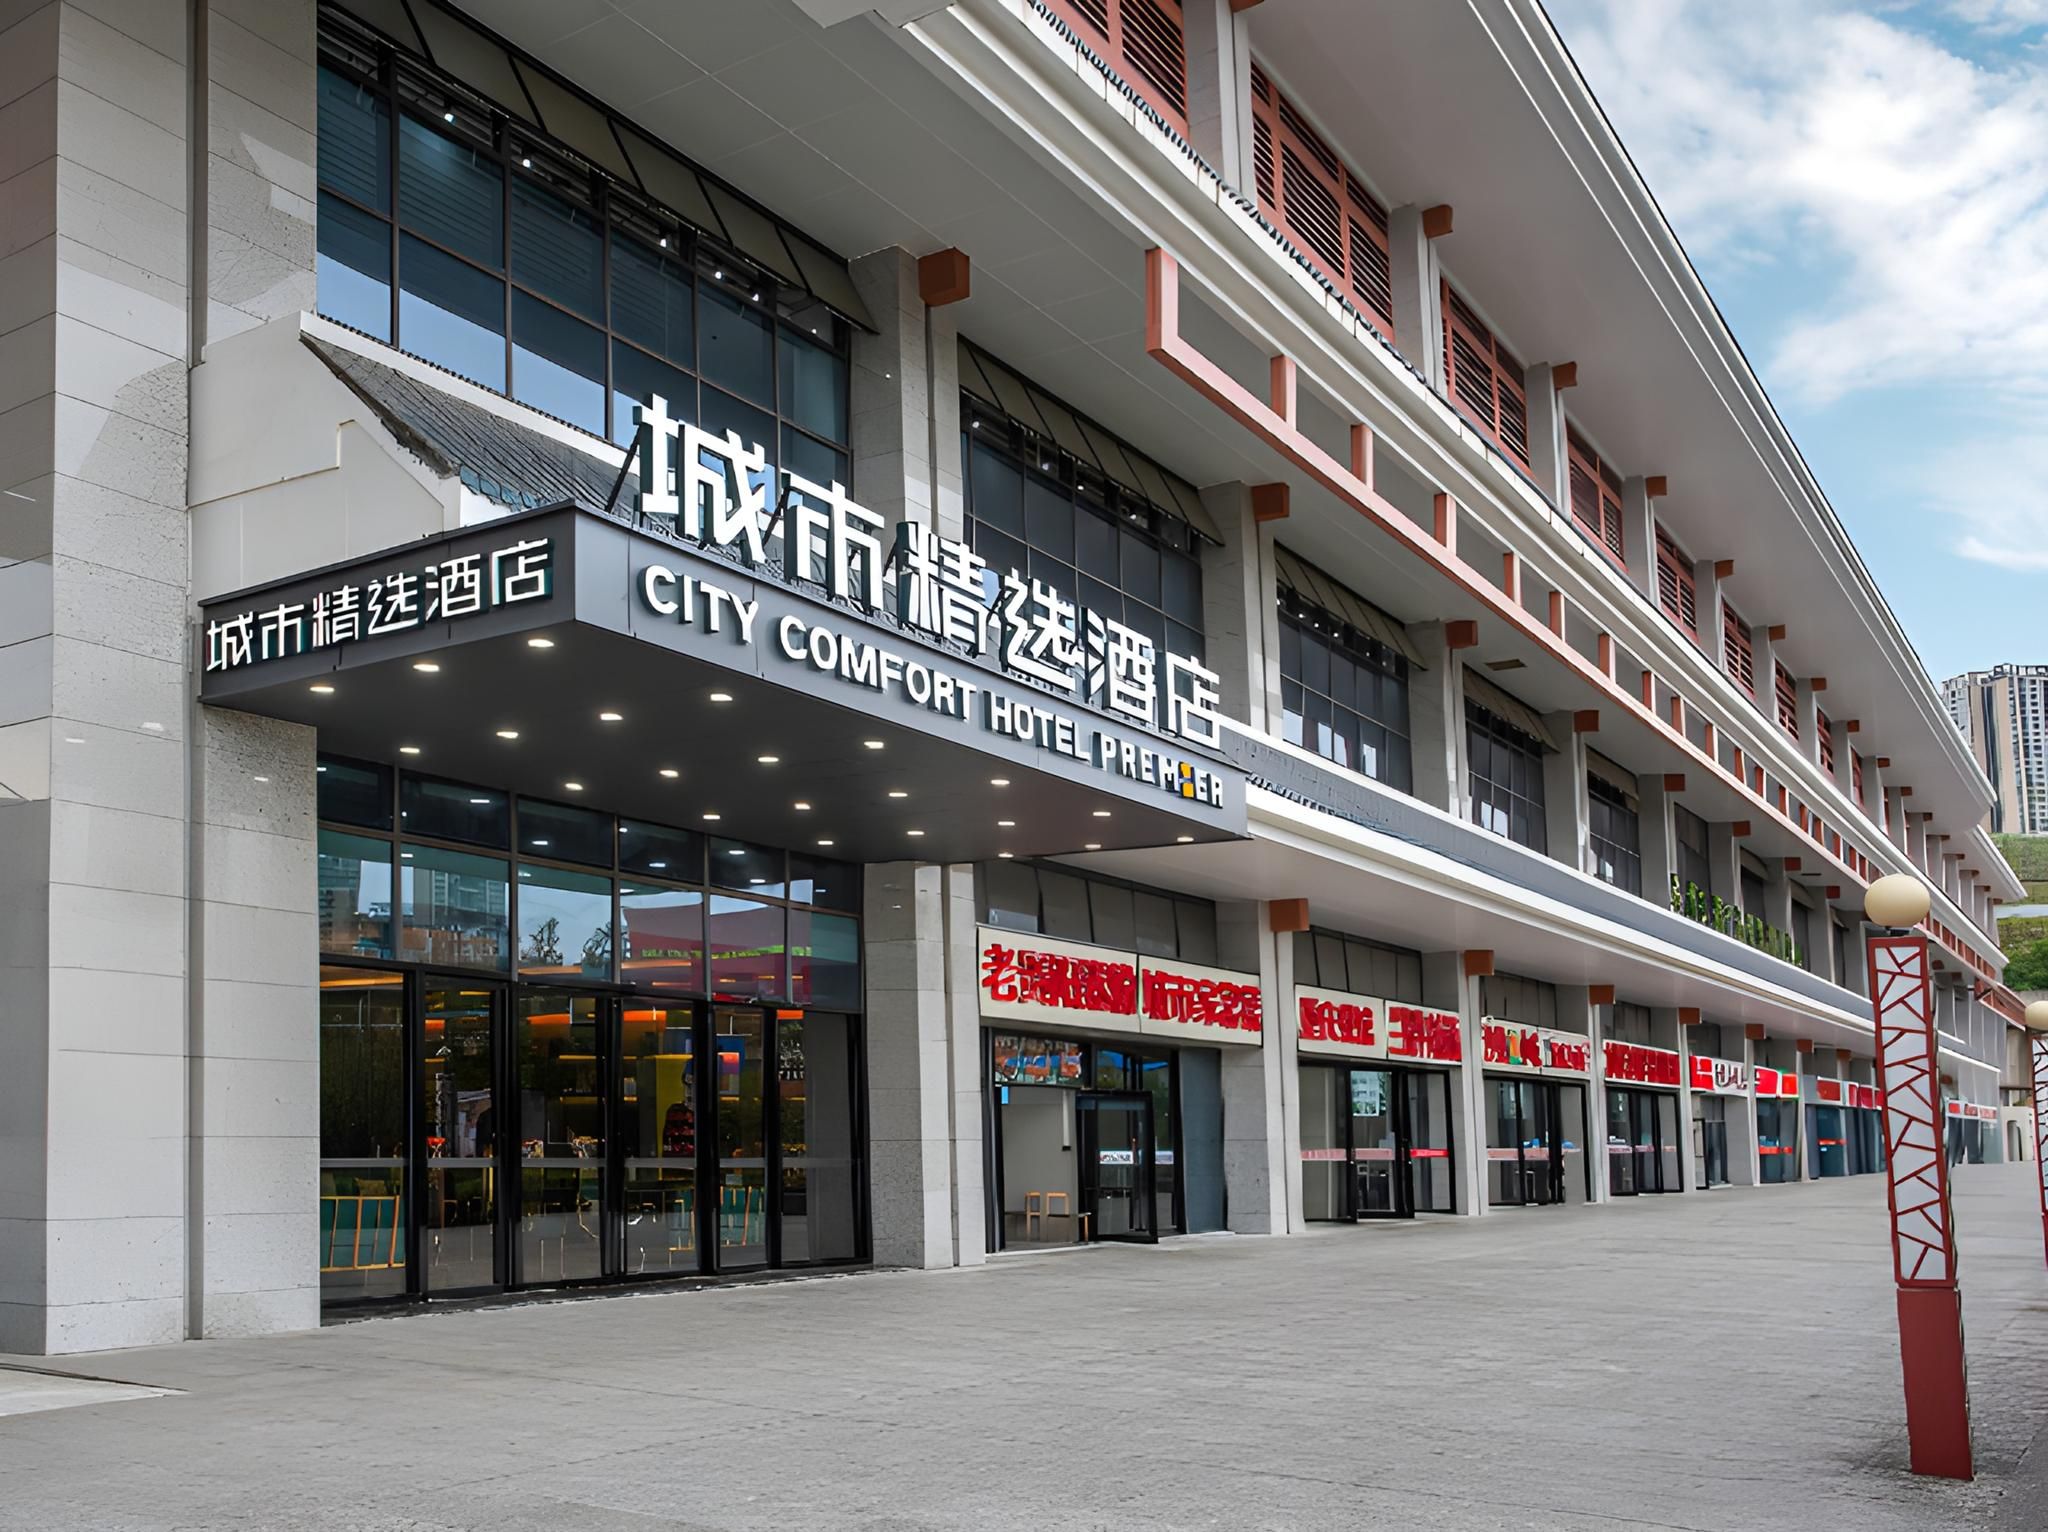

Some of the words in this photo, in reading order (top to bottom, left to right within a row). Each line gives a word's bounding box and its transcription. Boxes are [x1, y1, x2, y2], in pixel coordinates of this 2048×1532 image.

[206, 537, 550, 671] 城市精选酒店
[636, 393, 1222, 751] 城市精选酒店
[642, 565, 758, 645] CITY
[779, 614, 978, 722] COMFORT
[989, 690, 1091, 763] HOTEL
